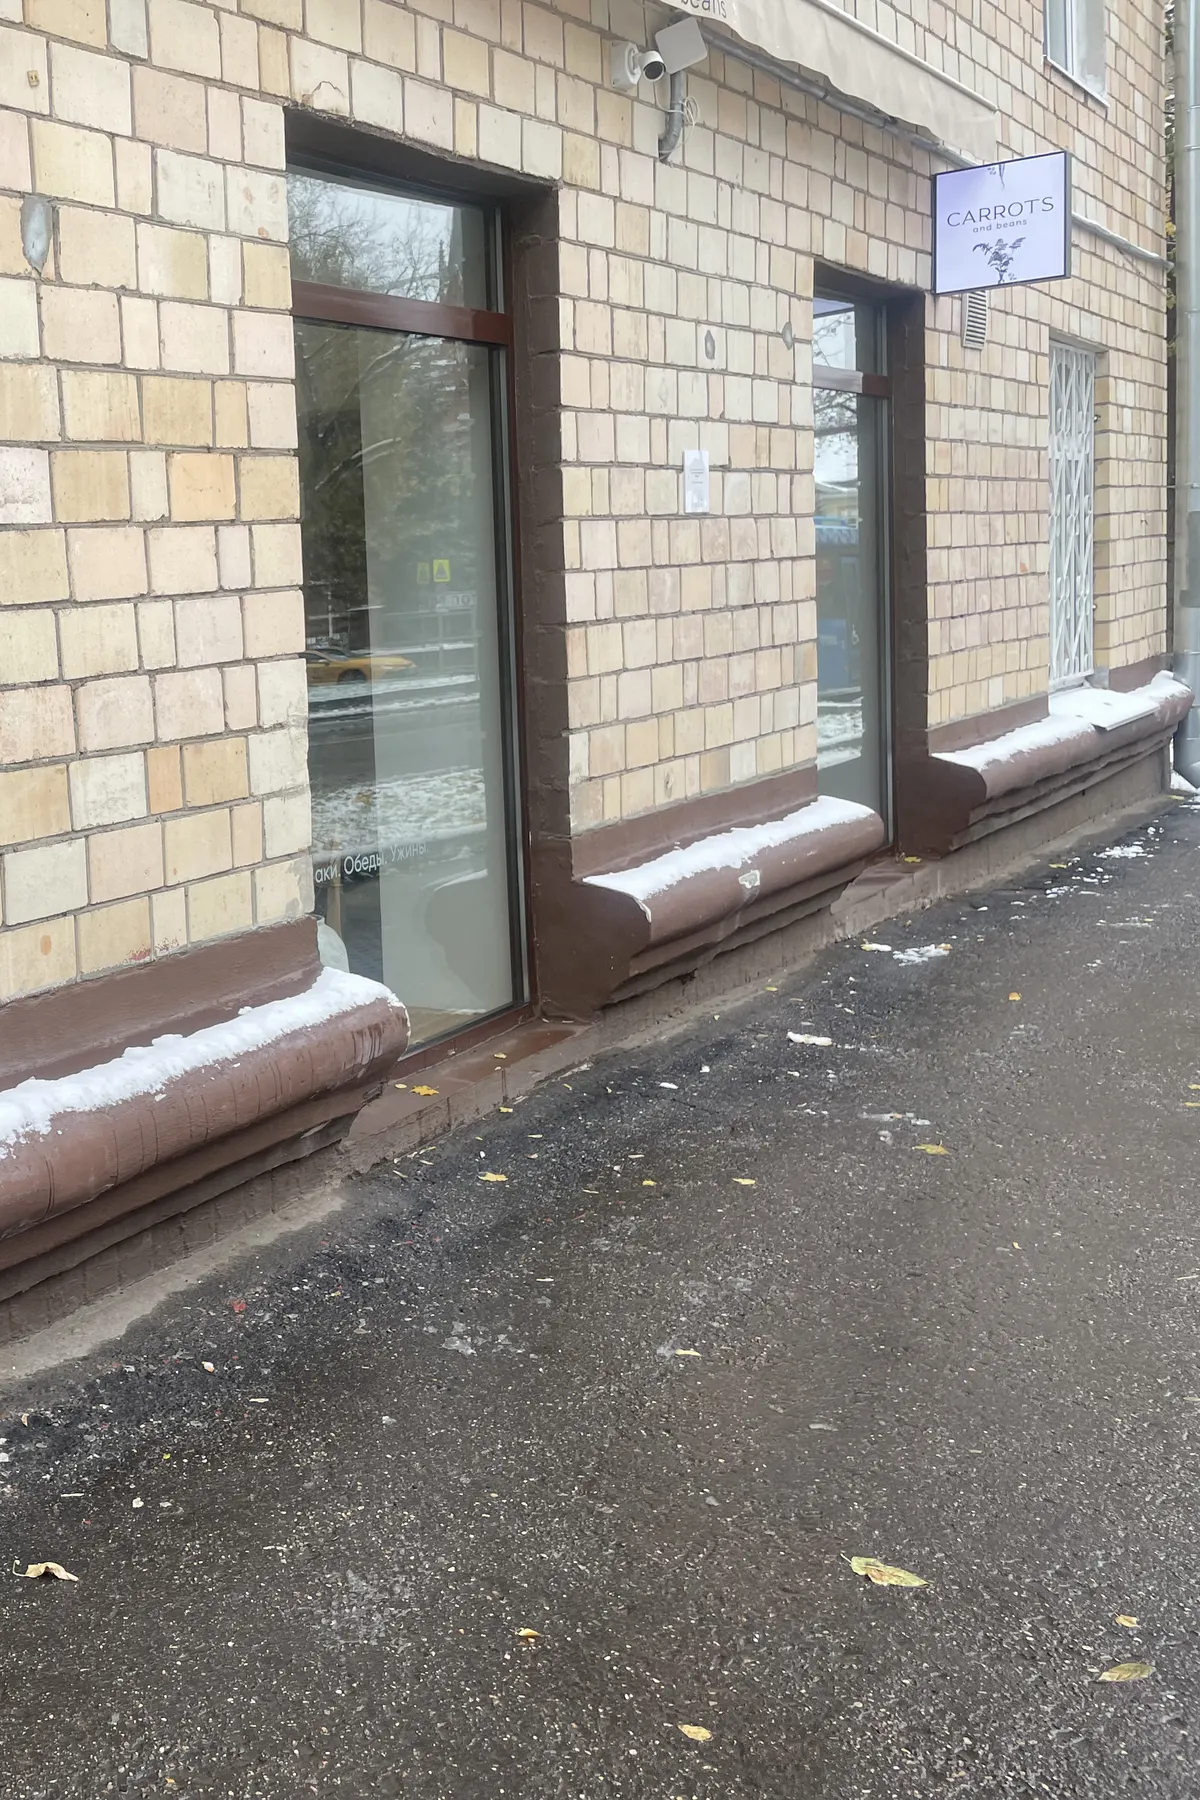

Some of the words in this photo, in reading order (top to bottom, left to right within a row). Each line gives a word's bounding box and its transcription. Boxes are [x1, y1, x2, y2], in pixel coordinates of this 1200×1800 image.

[946, 196, 1055, 227] CARROTS
[972, 224, 992, 233] and
[996, 219, 1028, 230] beans
[343, 852, 388, 875] Обеды.
